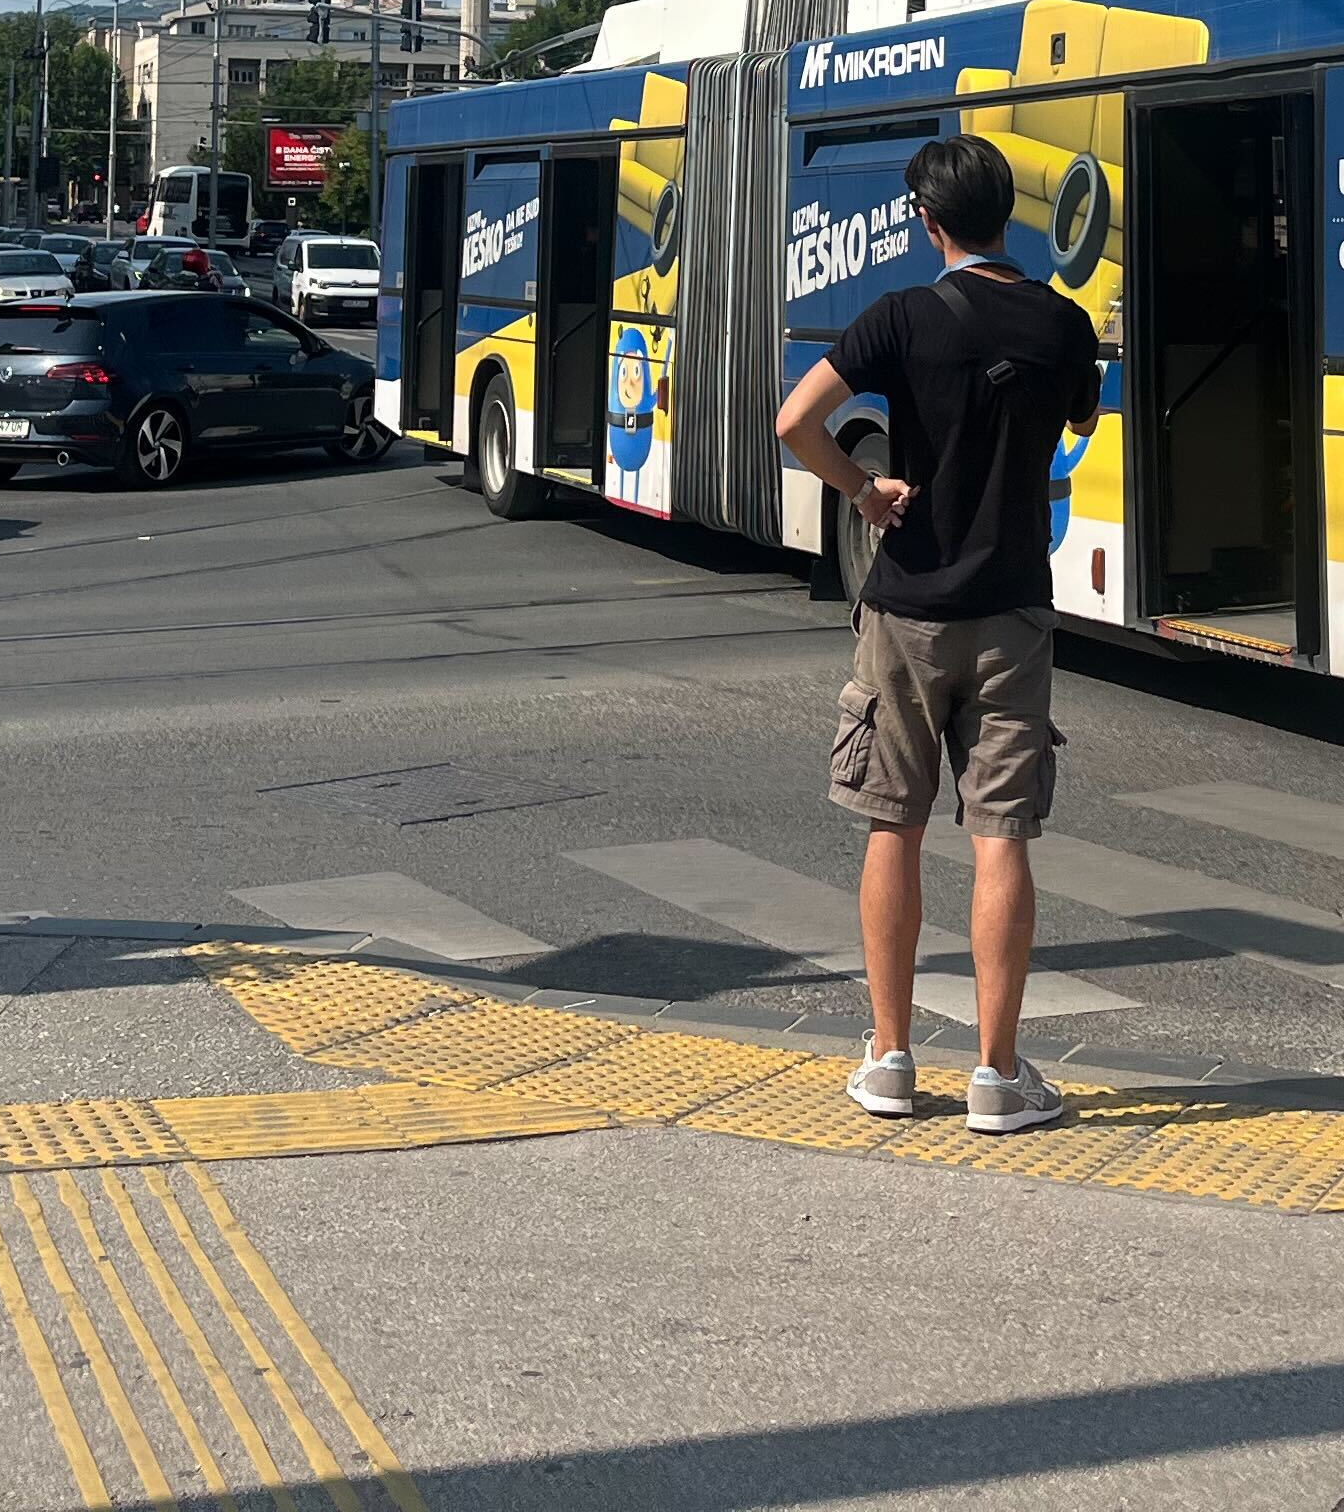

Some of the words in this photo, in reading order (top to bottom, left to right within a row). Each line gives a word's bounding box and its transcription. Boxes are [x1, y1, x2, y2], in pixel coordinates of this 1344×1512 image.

[834, 36, 945, 84] MIKROFIN
[792, 200, 819, 236] UZMI
[871, 203, 888, 235] DA
[890, 194, 907, 226] NE
[461, 217, 504, 279] KEŠKO
[786, 211, 867, 302] KEŠKO
[870, 227, 909, 266] TEŠKO!
